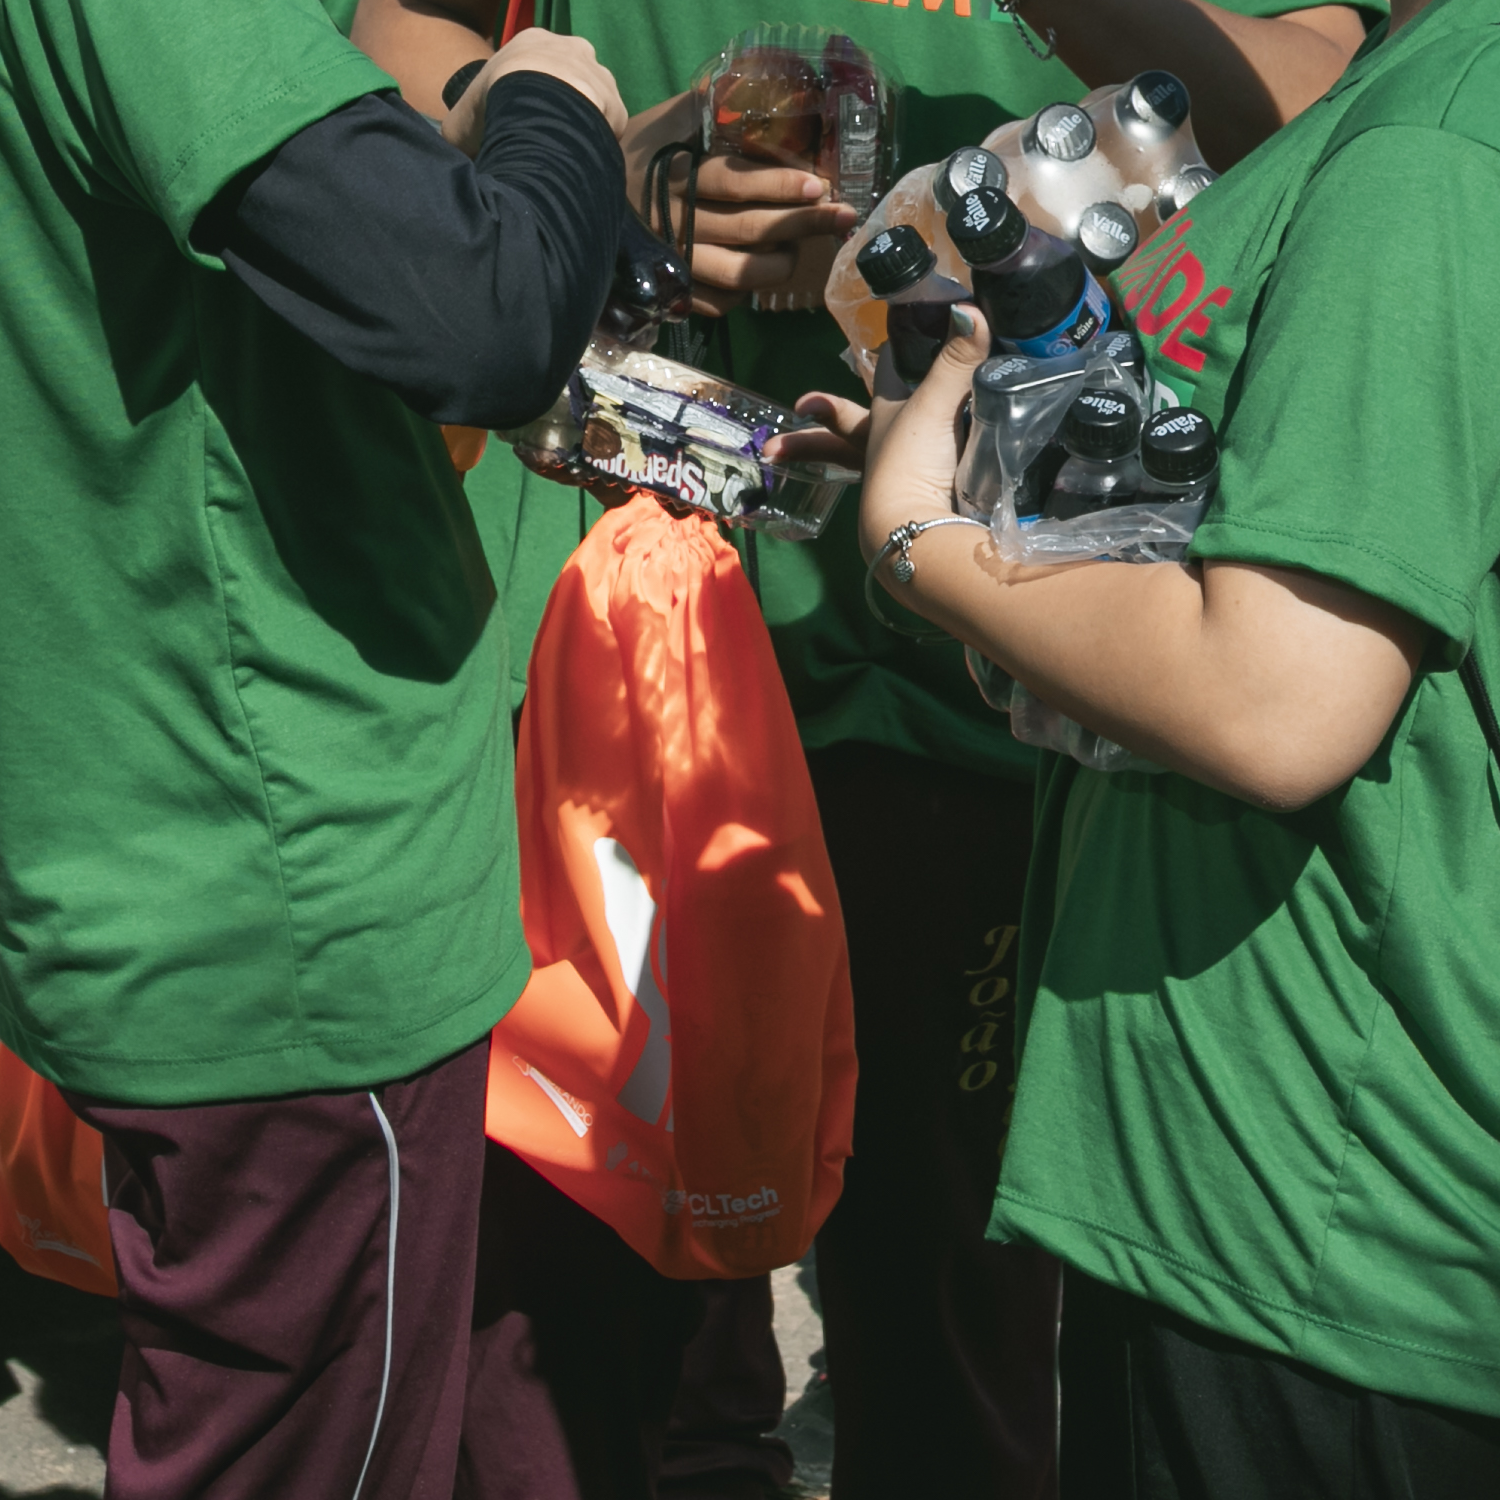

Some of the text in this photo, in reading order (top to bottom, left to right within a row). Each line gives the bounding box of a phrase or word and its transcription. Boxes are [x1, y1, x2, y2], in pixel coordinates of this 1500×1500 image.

[966, 195, 991, 232] Valle
[1092, 212, 1131, 245] Valle
[1081, 396, 1126, 415] Valle
[1152, 413, 1203, 437] Valle
[676, 1186, 779, 1216] CLTech
